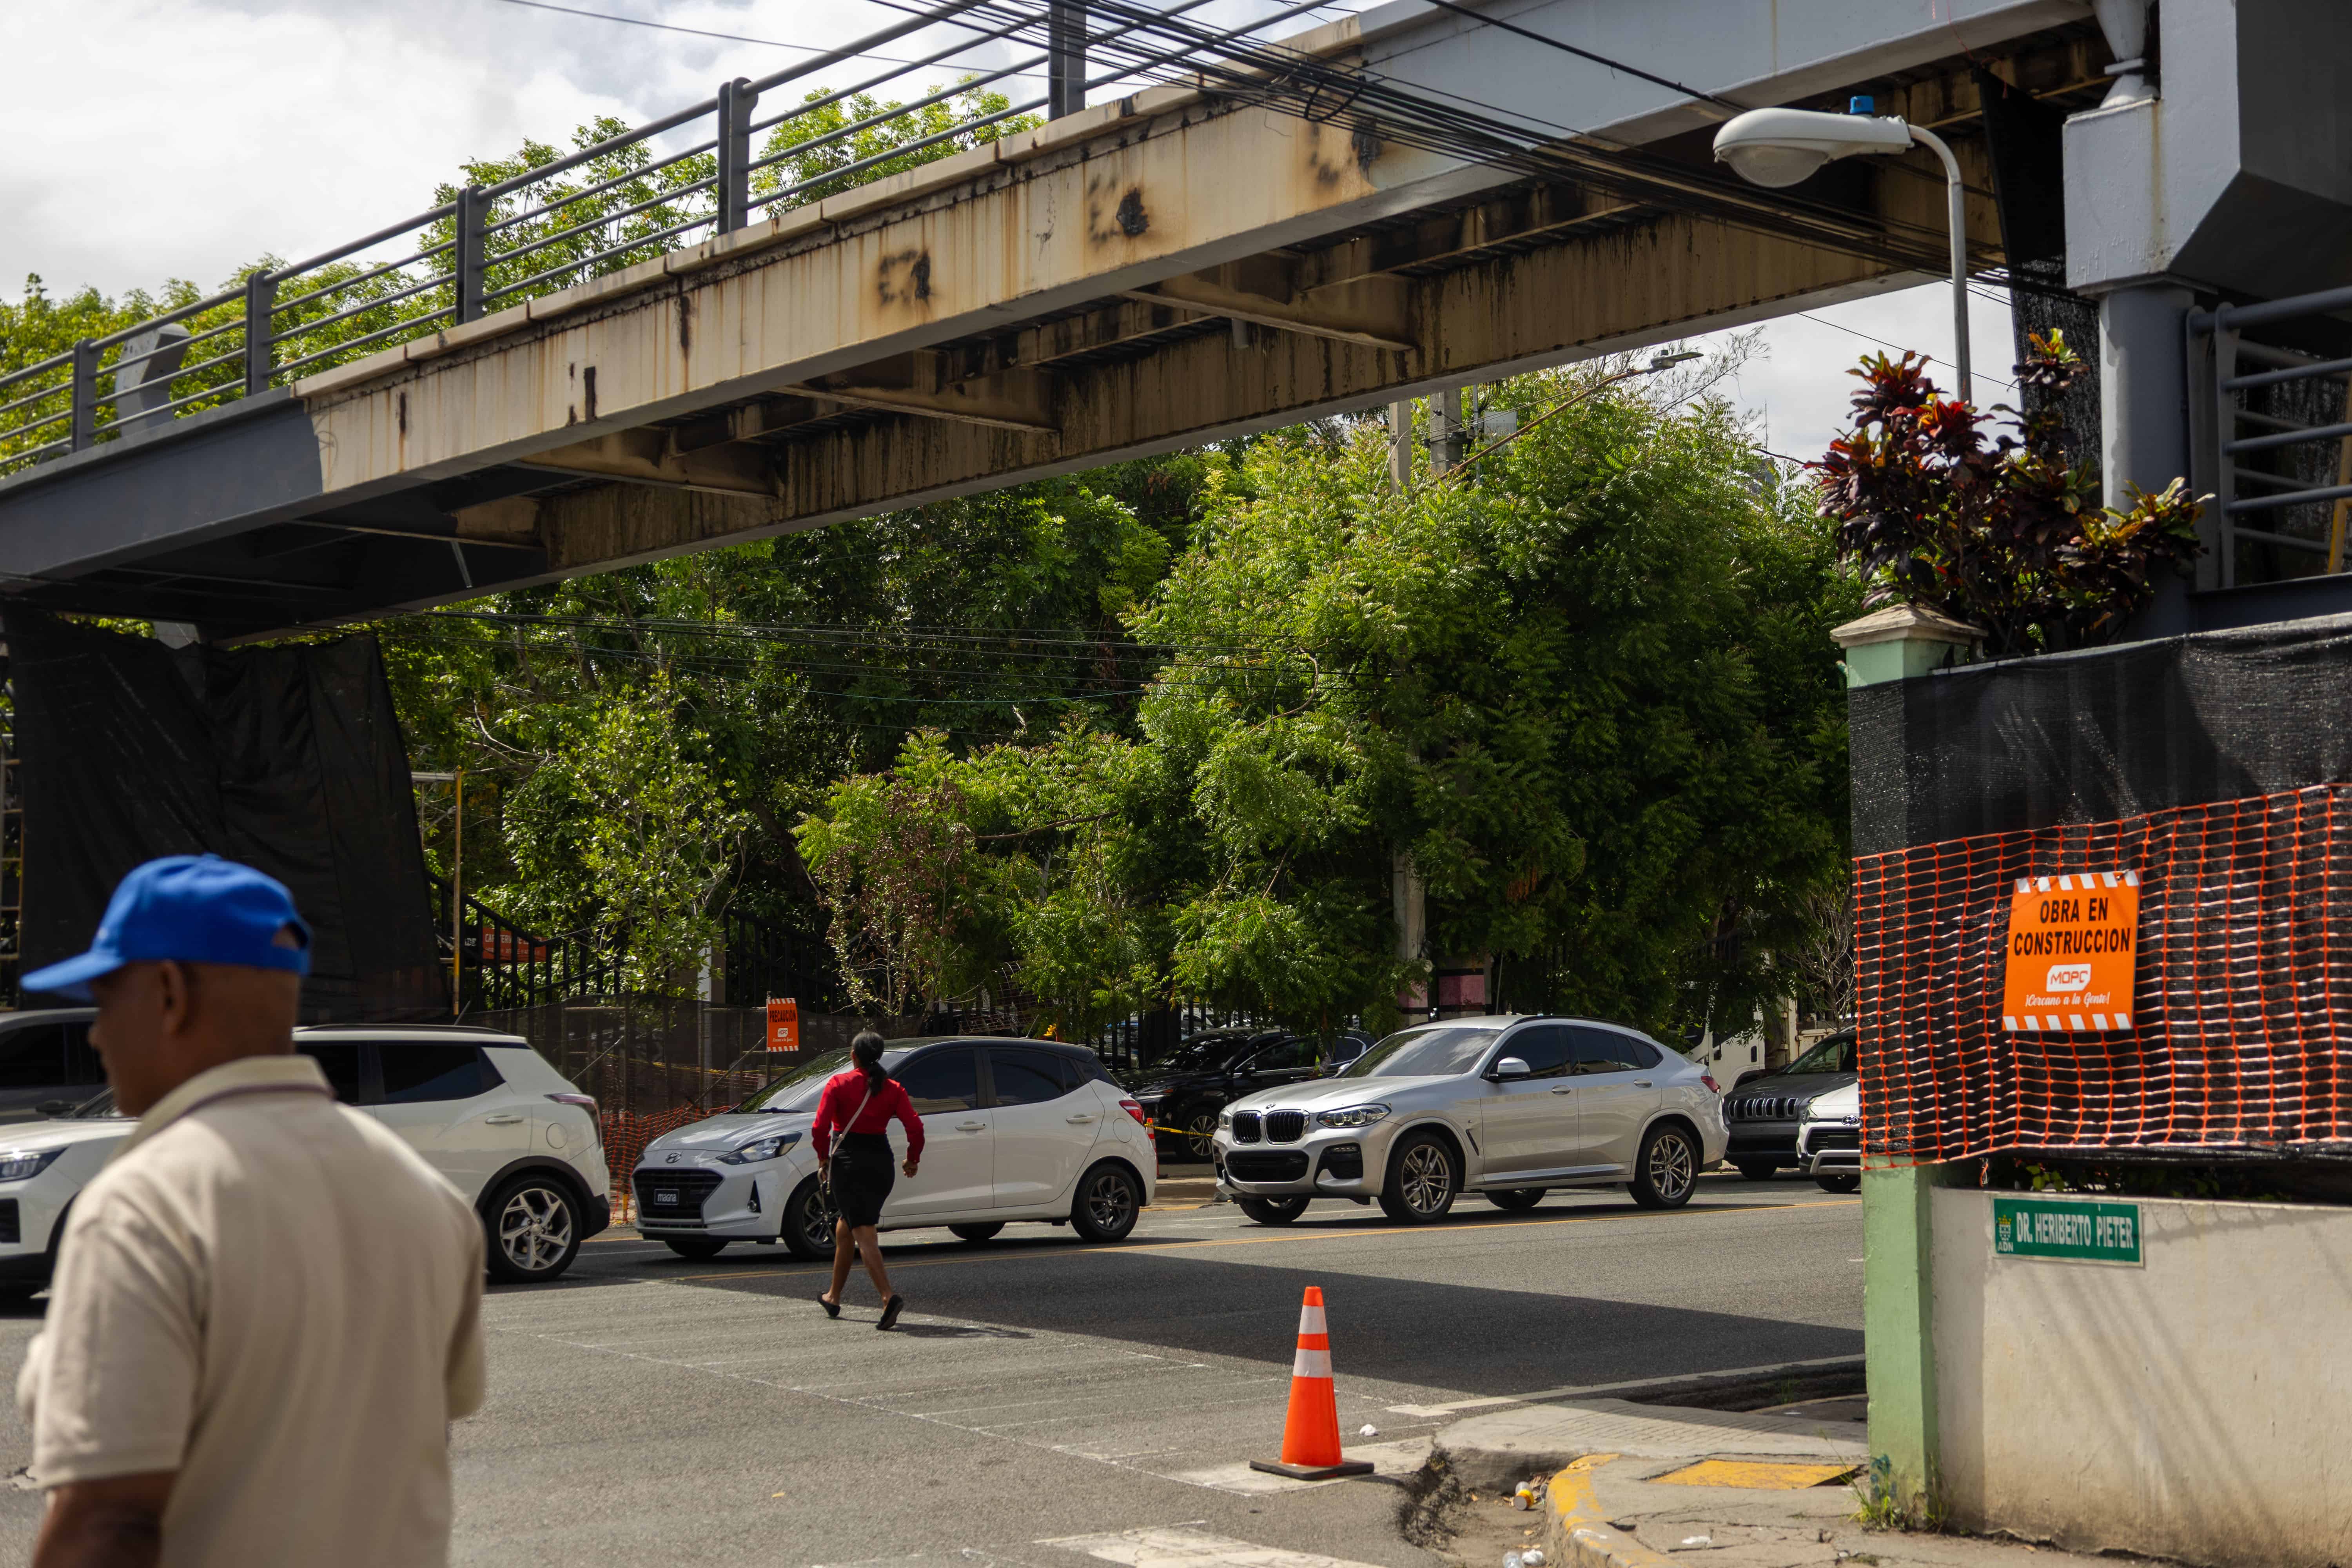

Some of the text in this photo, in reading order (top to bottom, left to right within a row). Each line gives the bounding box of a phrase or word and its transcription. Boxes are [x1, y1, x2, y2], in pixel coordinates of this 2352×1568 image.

[2040, 897, 2108, 924] OBRA EN
[2014, 928, 2131, 956] CONSTRUCCION
[2050, 970, 2088, 985] MOPC
[2063, 996, 2070, 1005] a
[2072, 992, 2081, 1005] la
[2016, 1212, 2134, 1249] DR. HERIBERTO PIETER
[1997, 1241, 2014, 1252] ADN
